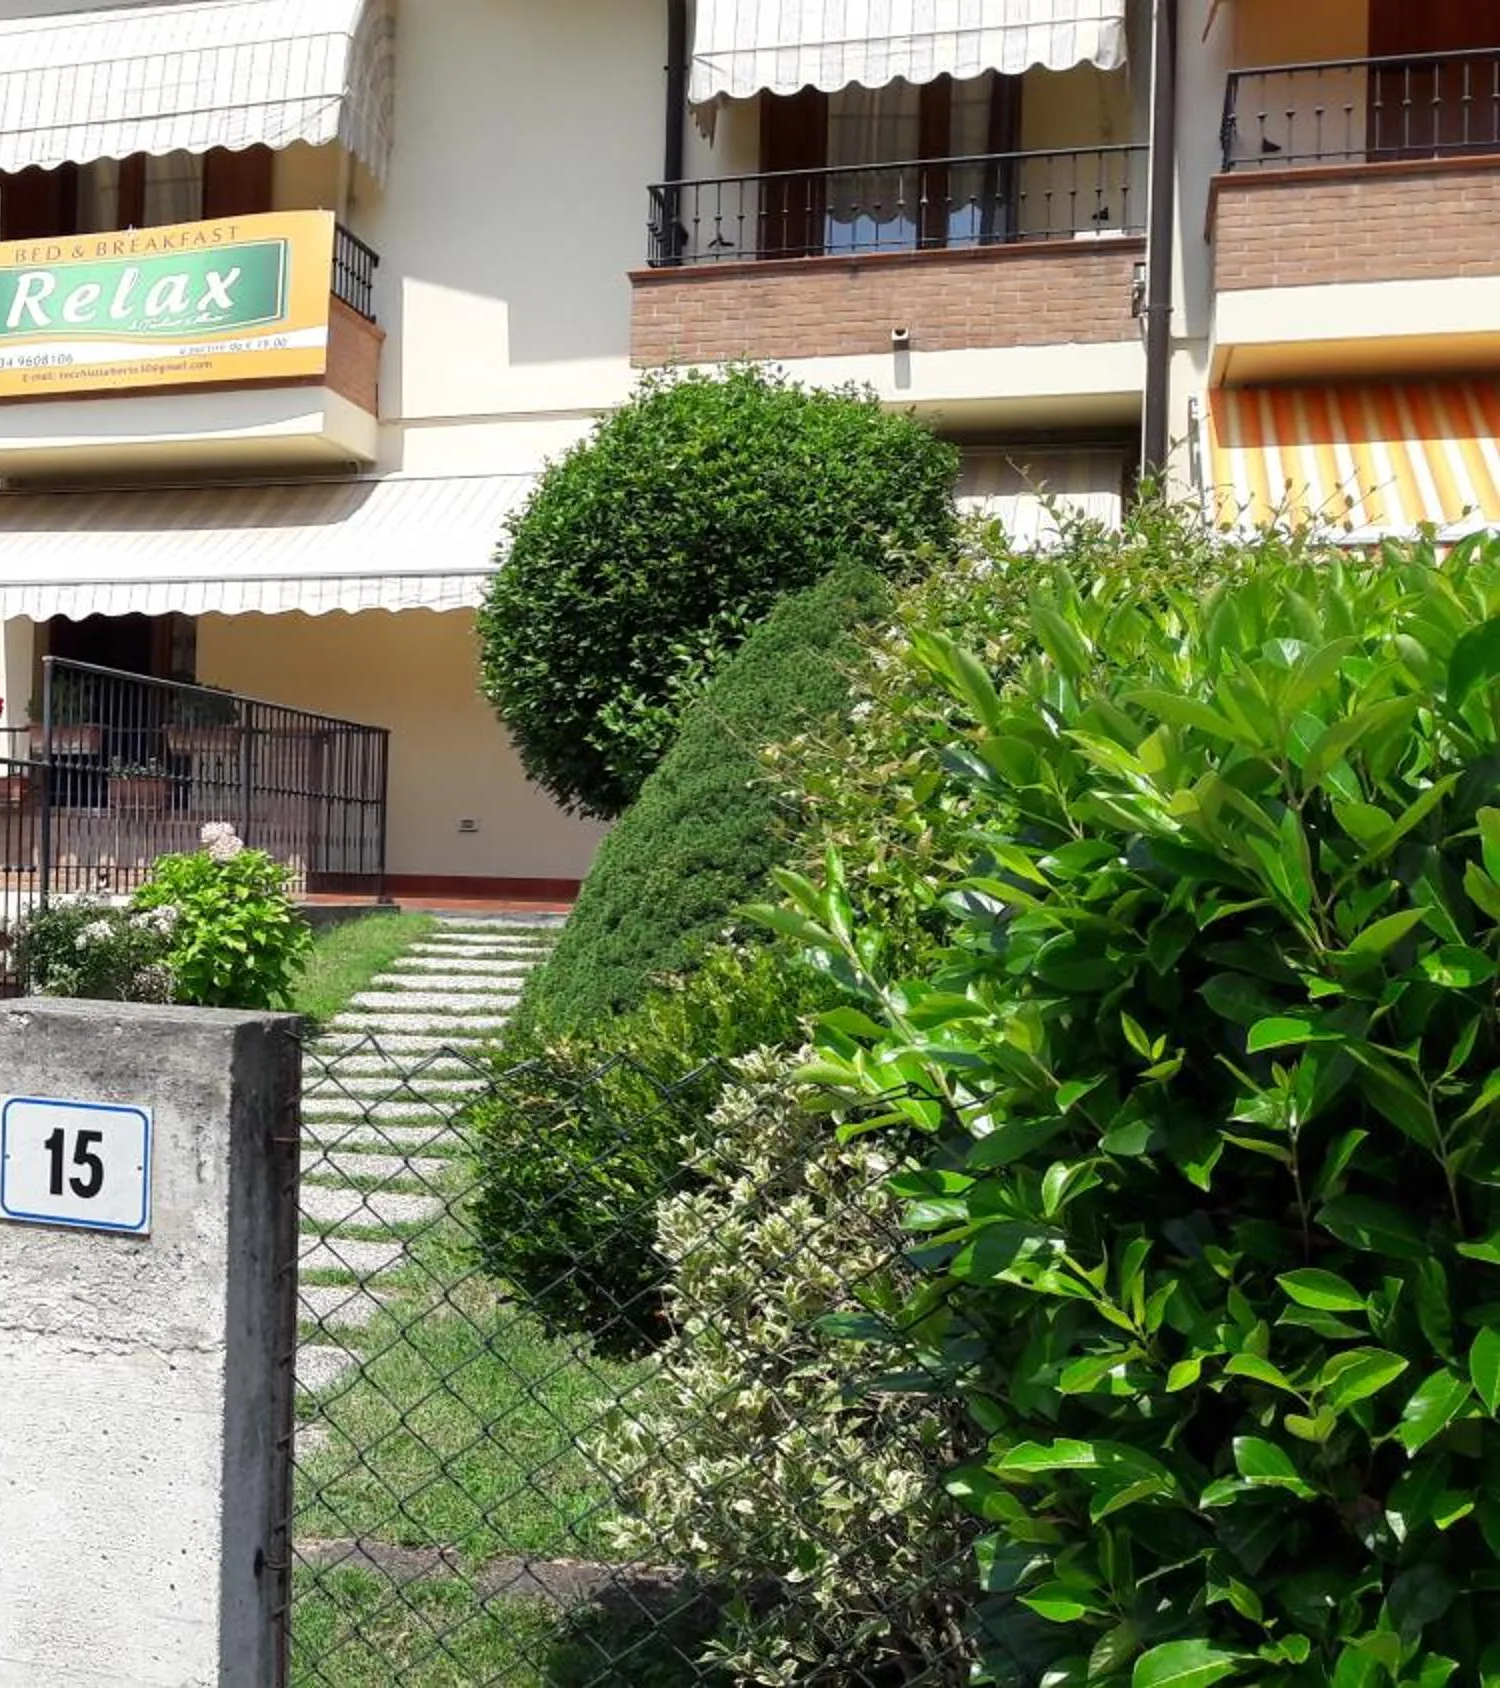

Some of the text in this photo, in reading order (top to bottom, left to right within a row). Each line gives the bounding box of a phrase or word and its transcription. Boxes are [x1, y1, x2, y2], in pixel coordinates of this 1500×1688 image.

[15, 225, 239, 263] BED & BREAKFAST
[6, 265, 241, 328] Relax
[44, 1128, 104, 1199] 15
